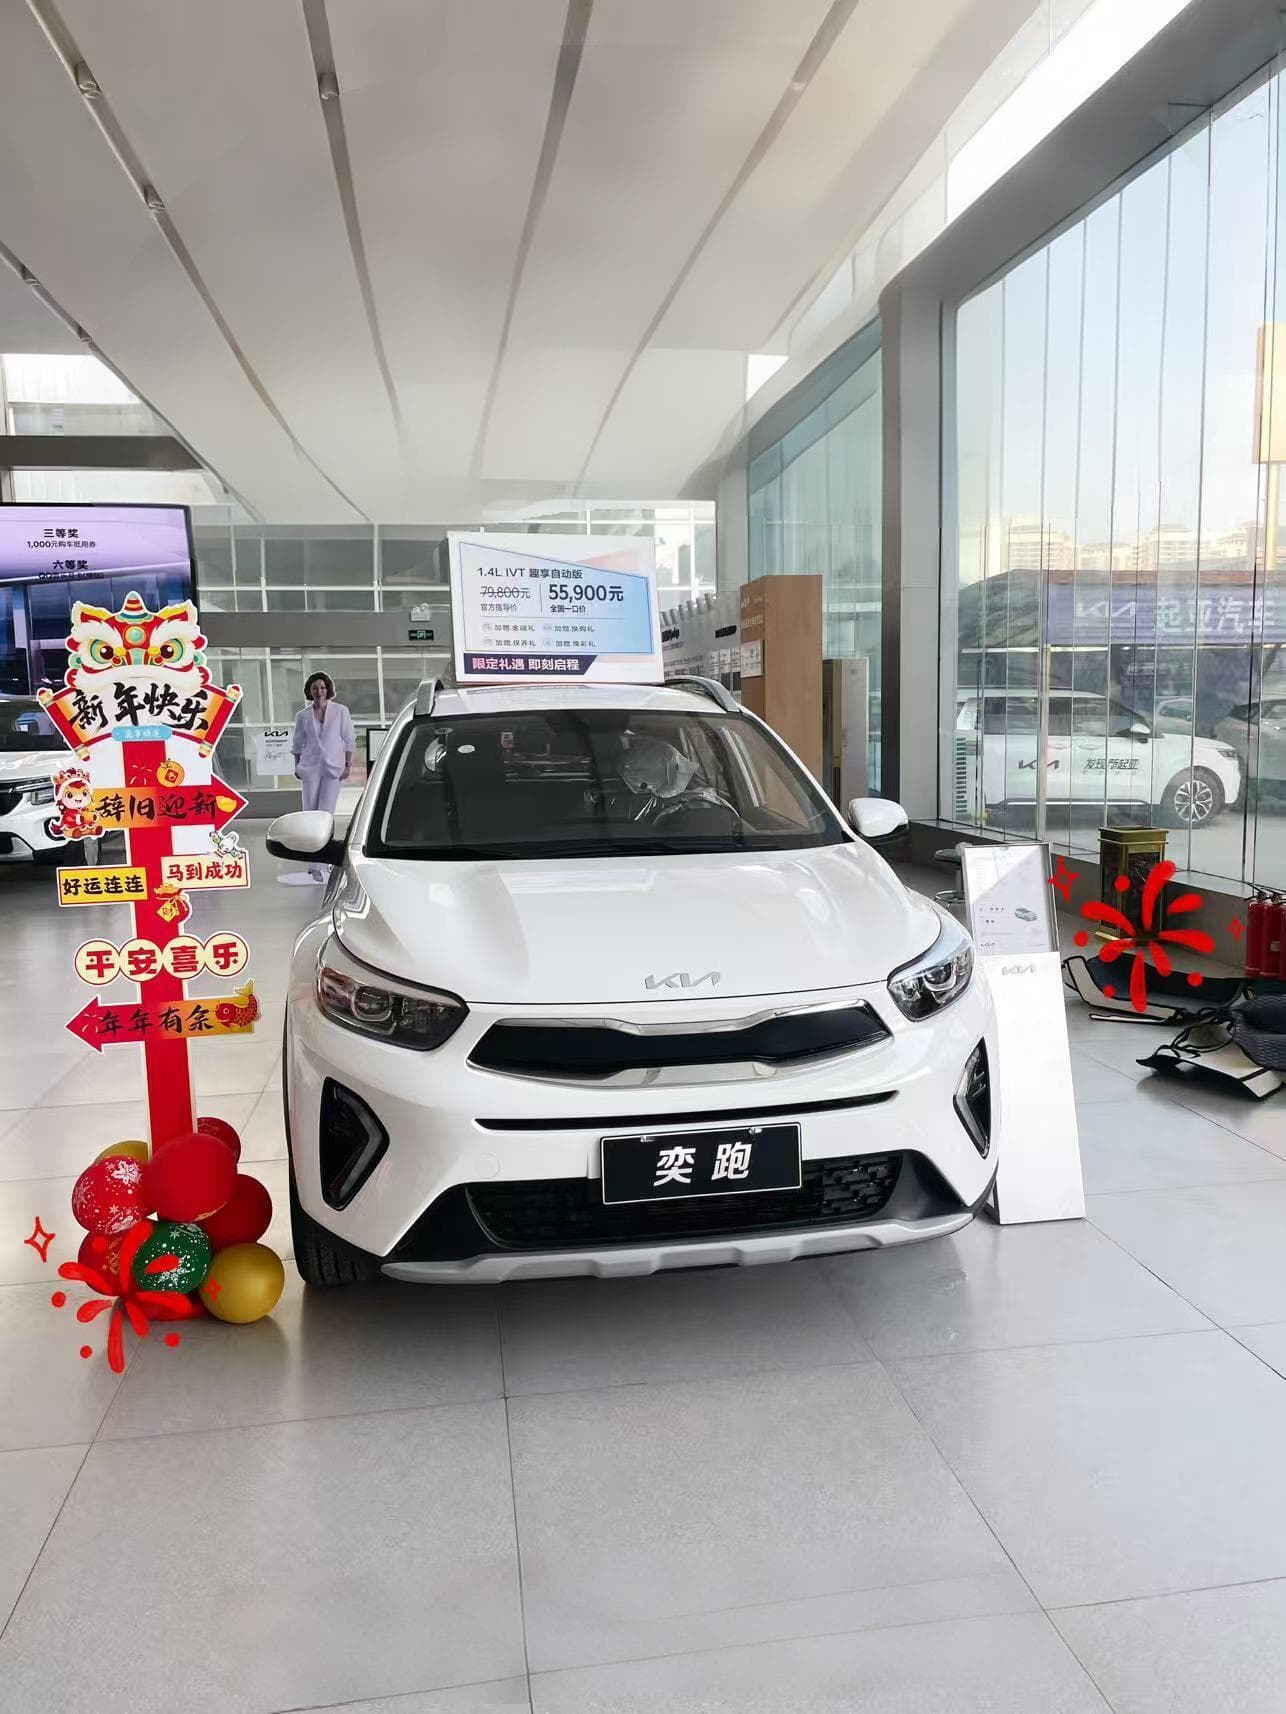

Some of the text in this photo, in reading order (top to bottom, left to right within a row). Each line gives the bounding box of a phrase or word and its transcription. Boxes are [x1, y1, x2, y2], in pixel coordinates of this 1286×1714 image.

[44, 528, 79, 539] 三等奖
[52, 560, 89, 570] 六等奖
[477, 567, 584, 579] 1.4L IVT 趣享自动版
[480, 586, 531, 599] 79,800元
[549, 583, 624, 603] 55,900元
[480, 603, 518, 612] 官方指导价
[550, 604, 587, 613] 全国一口价
[1155, 596, 1276, 633] 起亚汽车
[472, 657, 580, 671] 限定礼遇 即刻启程
[68, 682, 210, 731] 新年快乐
[94, 791, 217, 820] 辞旧迎新
[166, 861, 243, 882] 马到成功
[63, 874, 145, 897] 好运连连
[85, 941, 240, 978] 平安喜乐
[644, 971, 721, 990] KIA
[101, 1003, 215, 1036] 年年有余
[653, 1141, 752, 1187] 奕跑
